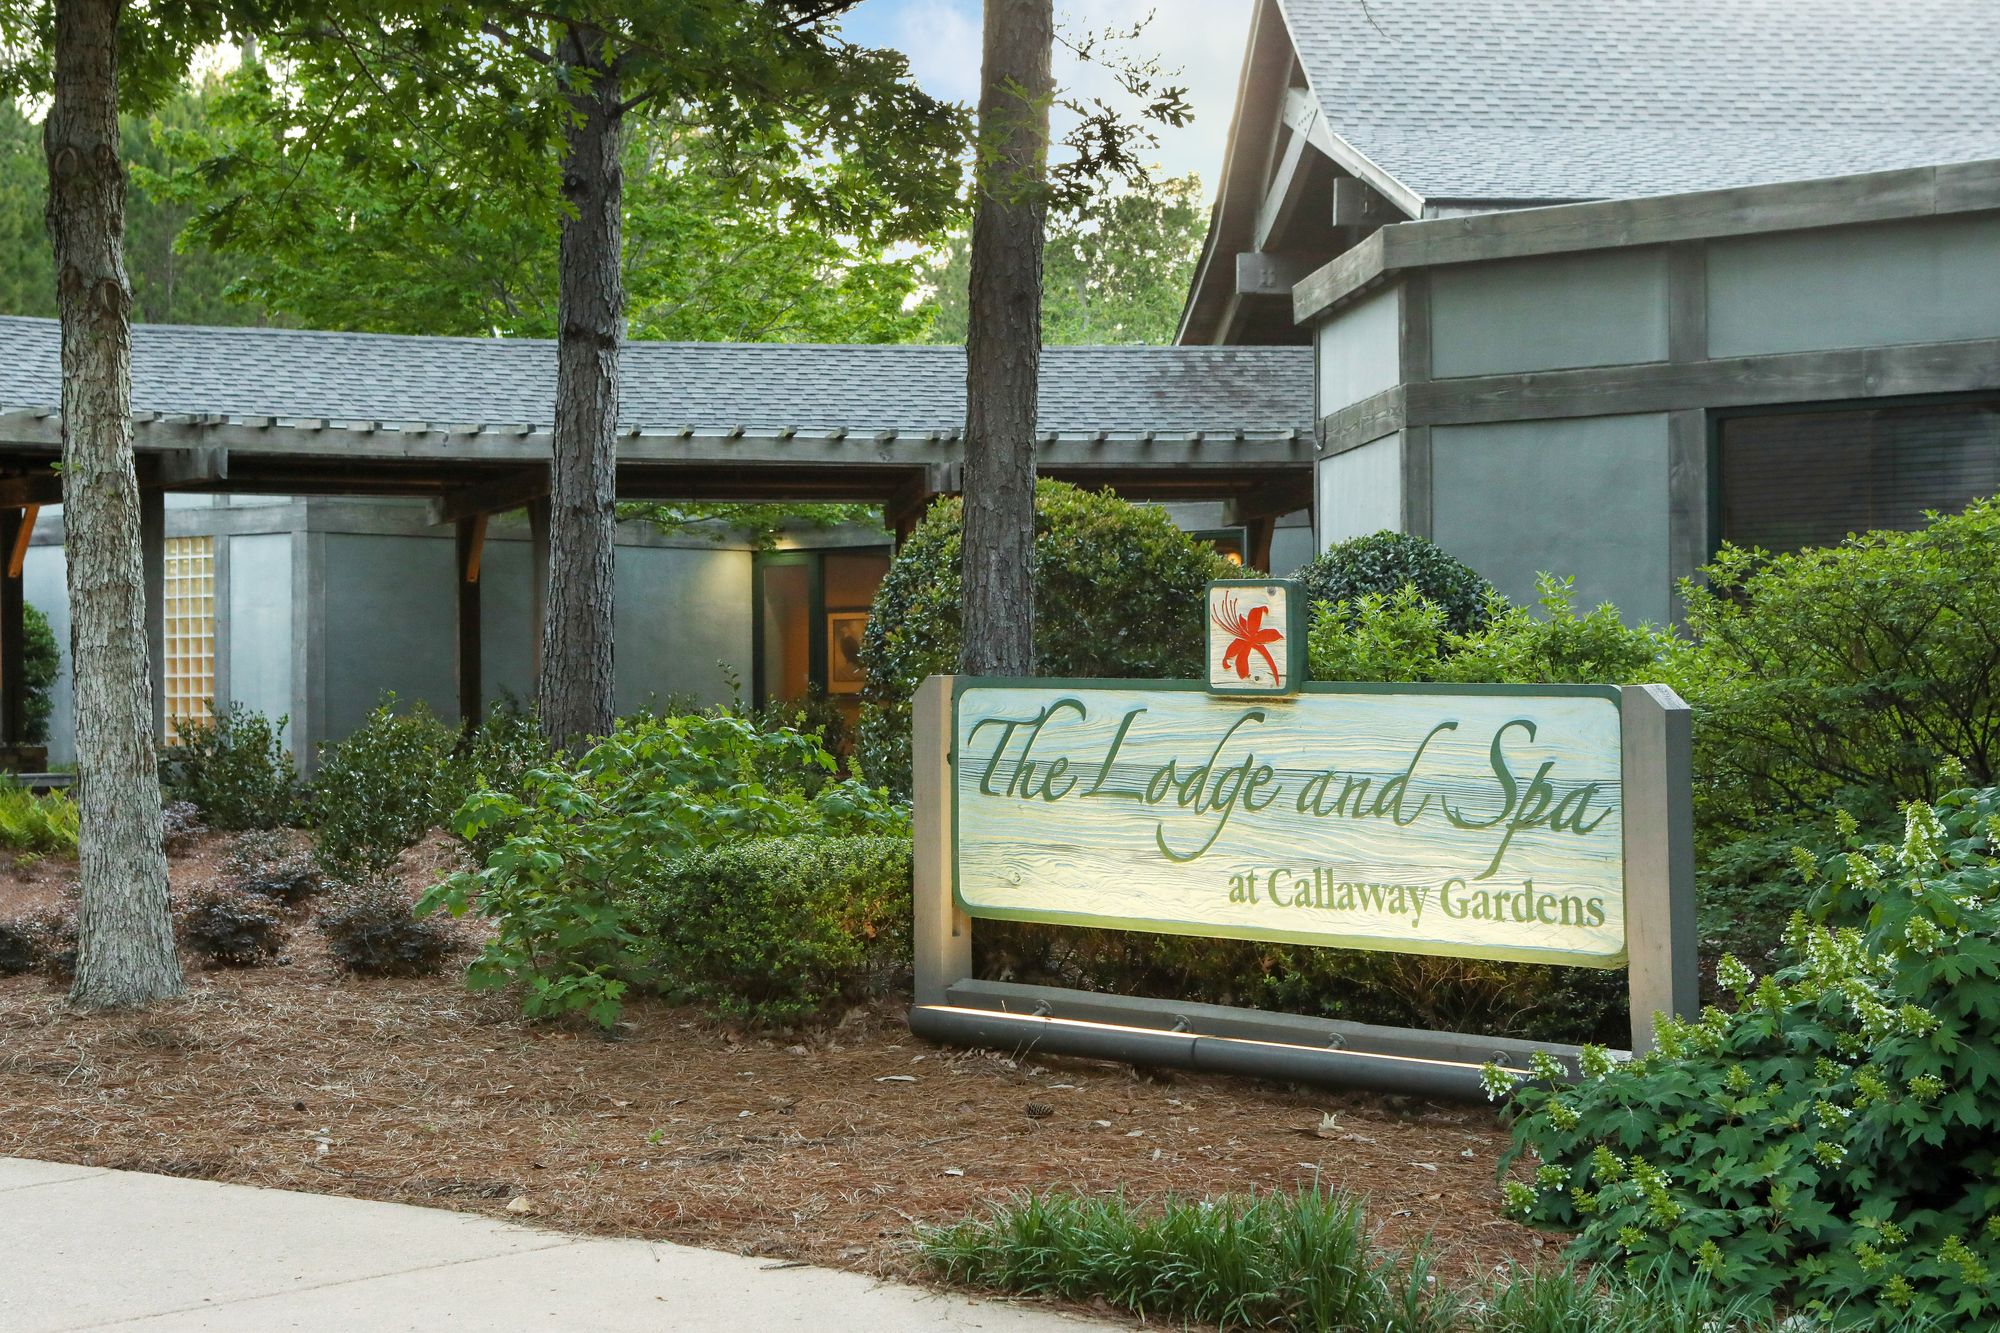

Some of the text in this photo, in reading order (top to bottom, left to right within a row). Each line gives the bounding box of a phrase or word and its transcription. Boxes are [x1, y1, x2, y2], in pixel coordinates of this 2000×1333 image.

[967, 699, 1612, 880] The Lodge and Spa
[1228, 868, 1606, 928] at Callaway Gardens
